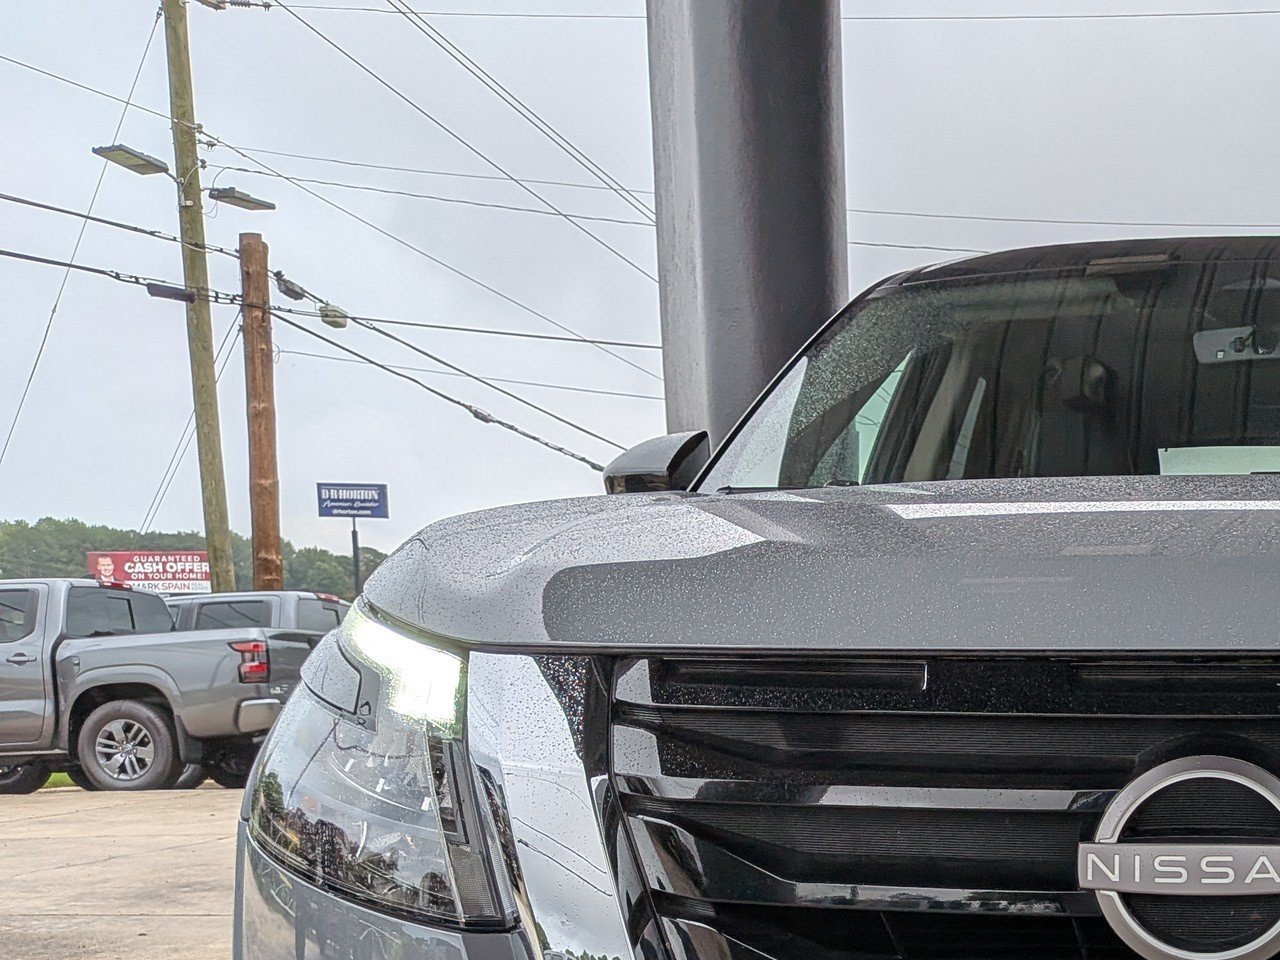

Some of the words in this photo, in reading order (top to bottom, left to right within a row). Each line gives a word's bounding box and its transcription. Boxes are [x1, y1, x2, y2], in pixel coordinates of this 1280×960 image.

[124, 562, 163, 573] CASH
[165, 562, 209, 573] OFFER
[161, 582, 190, 590] SPAIN
